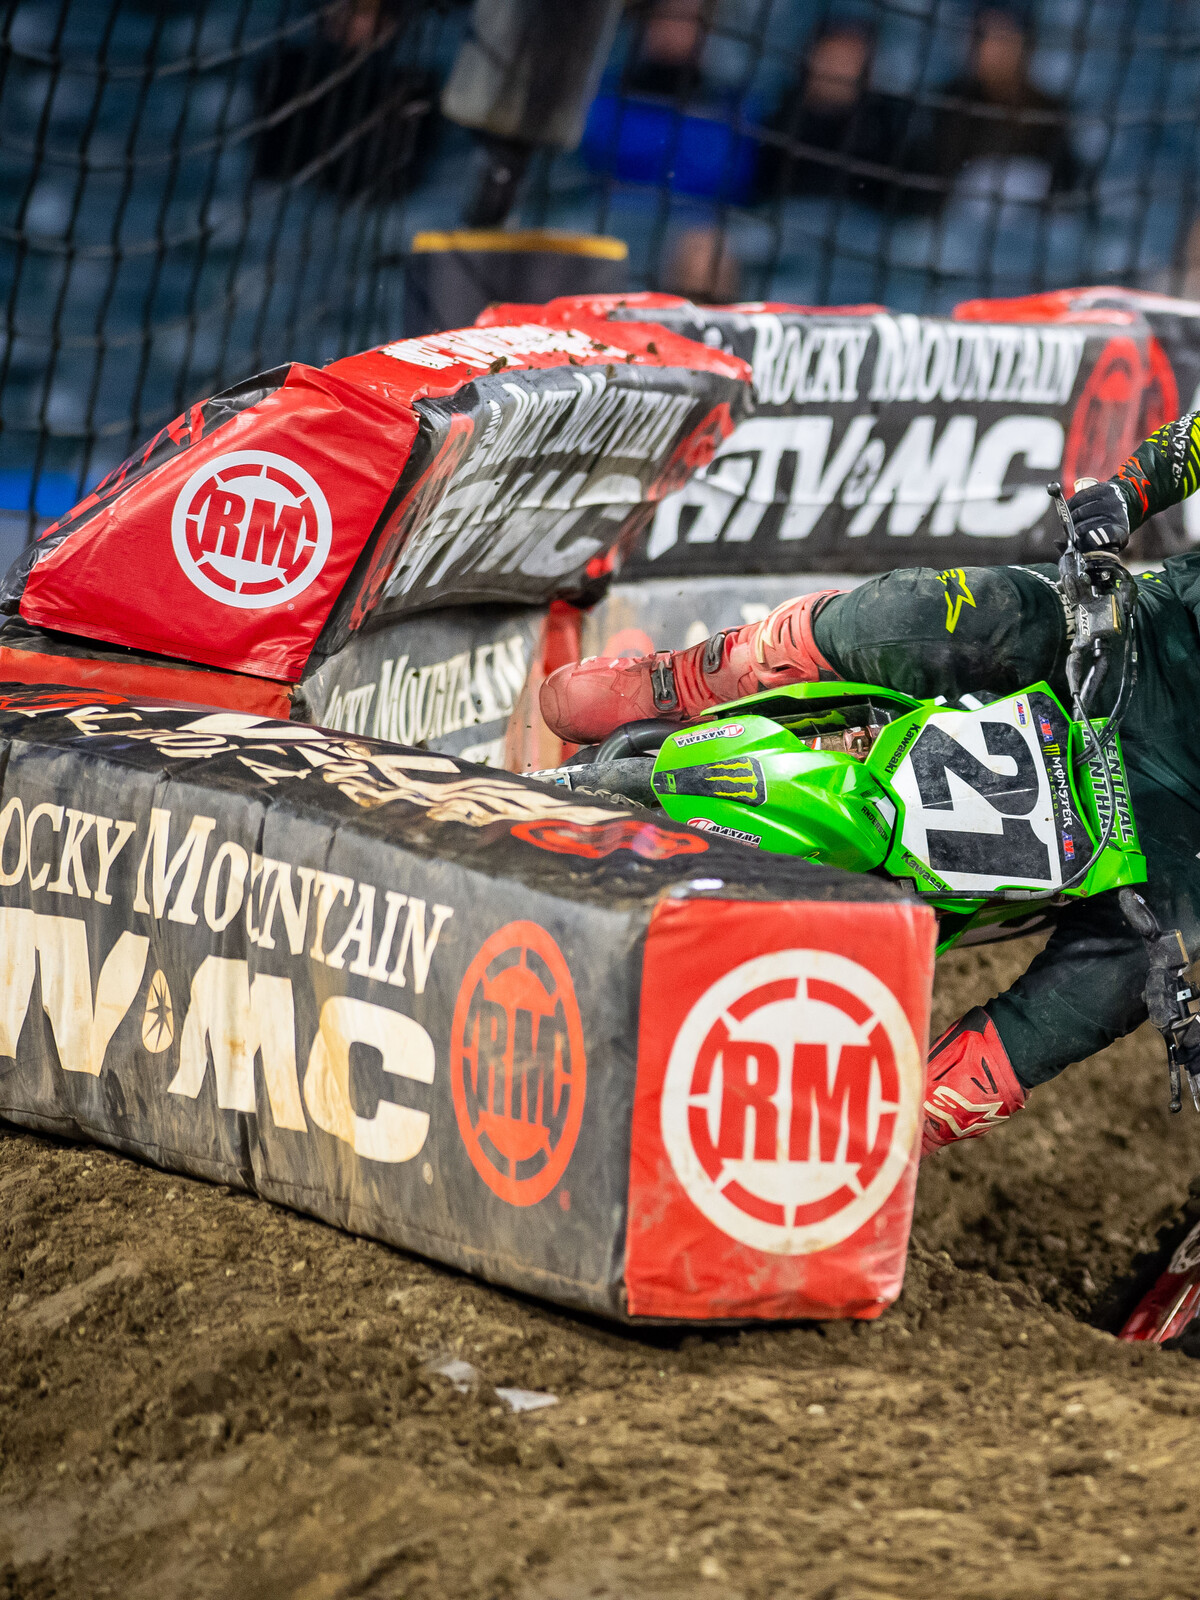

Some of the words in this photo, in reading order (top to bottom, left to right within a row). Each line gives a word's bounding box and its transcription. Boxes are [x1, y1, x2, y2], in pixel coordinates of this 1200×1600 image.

[752, 313, 872, 404] ROCKY
[868, 313, 1088, 404] MOUNTAIN
[200, 490, 306, 567] RM
[1079, 603, 1092, 636] ARC
[885, 722, 921, 775] Kawasaki
[860, 805, 889, 843] ANDERSON
[909, 720, 1052, 881] 21
[0, 796, 137, 905] OCKY
[900, 852, 948, 892] Kawasak
[167, 954, 436, 1163] MC
[719, 1040, 882, 1163] RM
